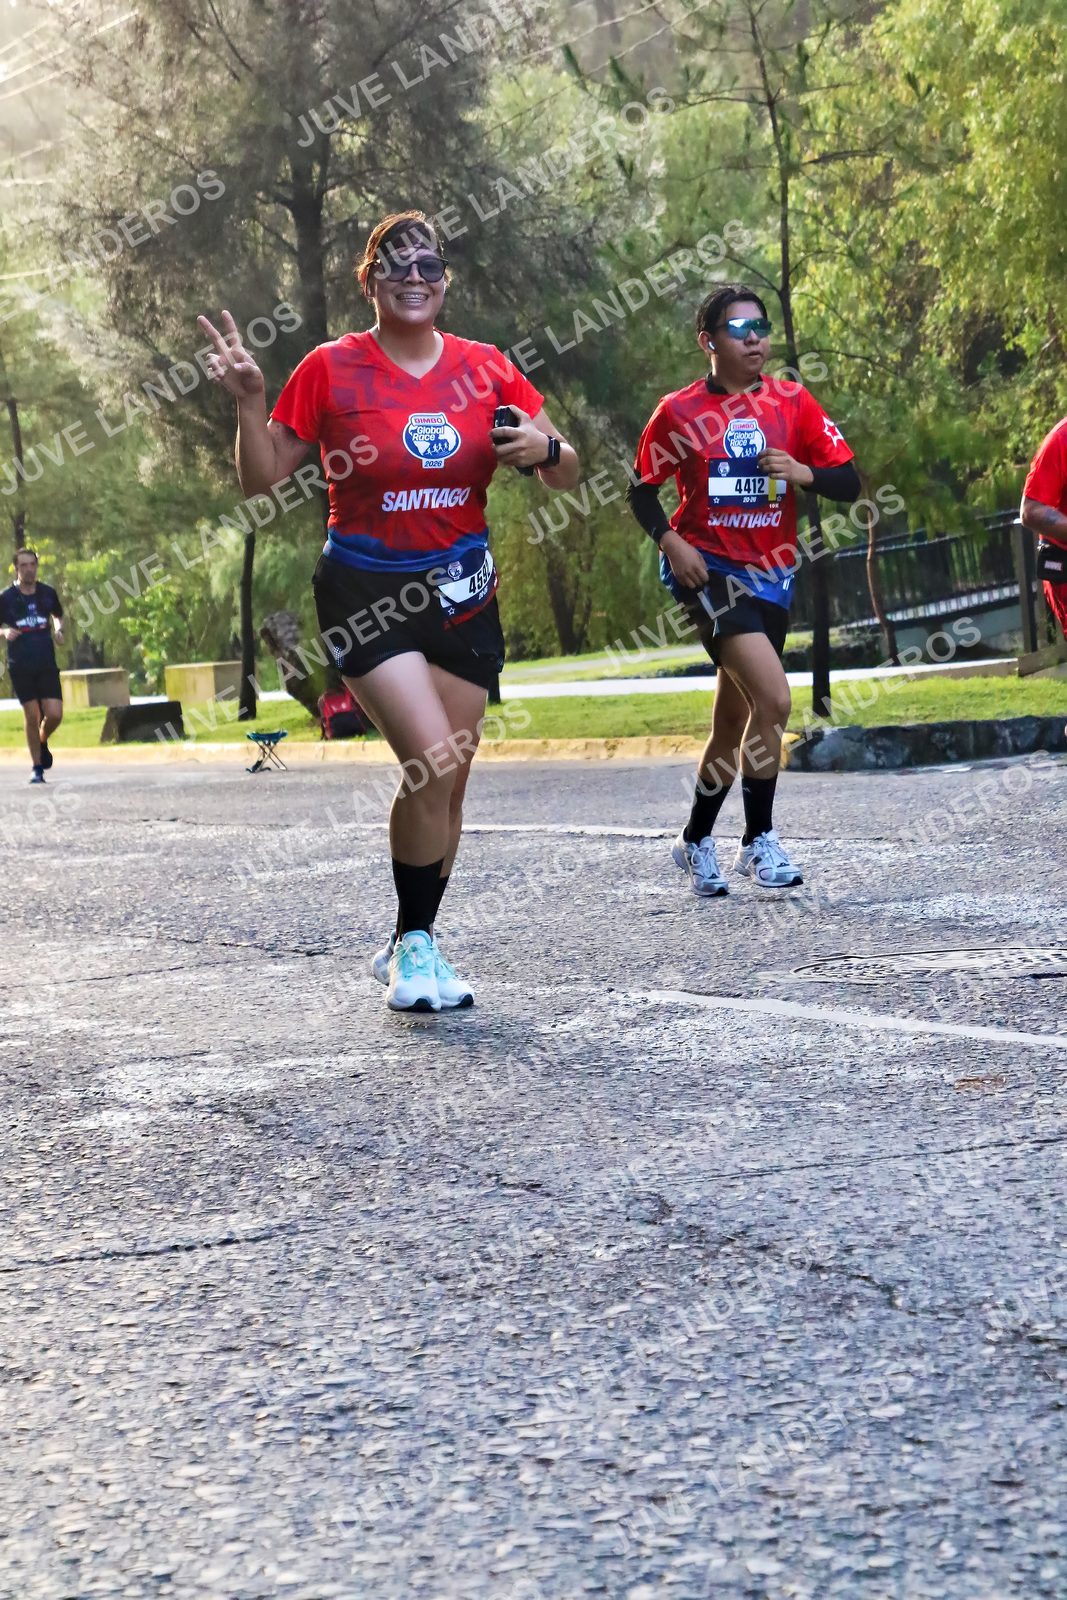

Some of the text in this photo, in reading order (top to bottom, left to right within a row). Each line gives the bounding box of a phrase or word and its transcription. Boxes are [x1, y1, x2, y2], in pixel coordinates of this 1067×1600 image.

[416, 426, 444, 435] Global
[412, 433, 436, 441] Race
[733, 431, 755, 440] Global
[730, 439, 748, 447] Race
[734, 478, 765, 494] 4412
[381, 486, 471, 512] SANTIAGO
[707, 510, 782, 529] SANTIAGO
